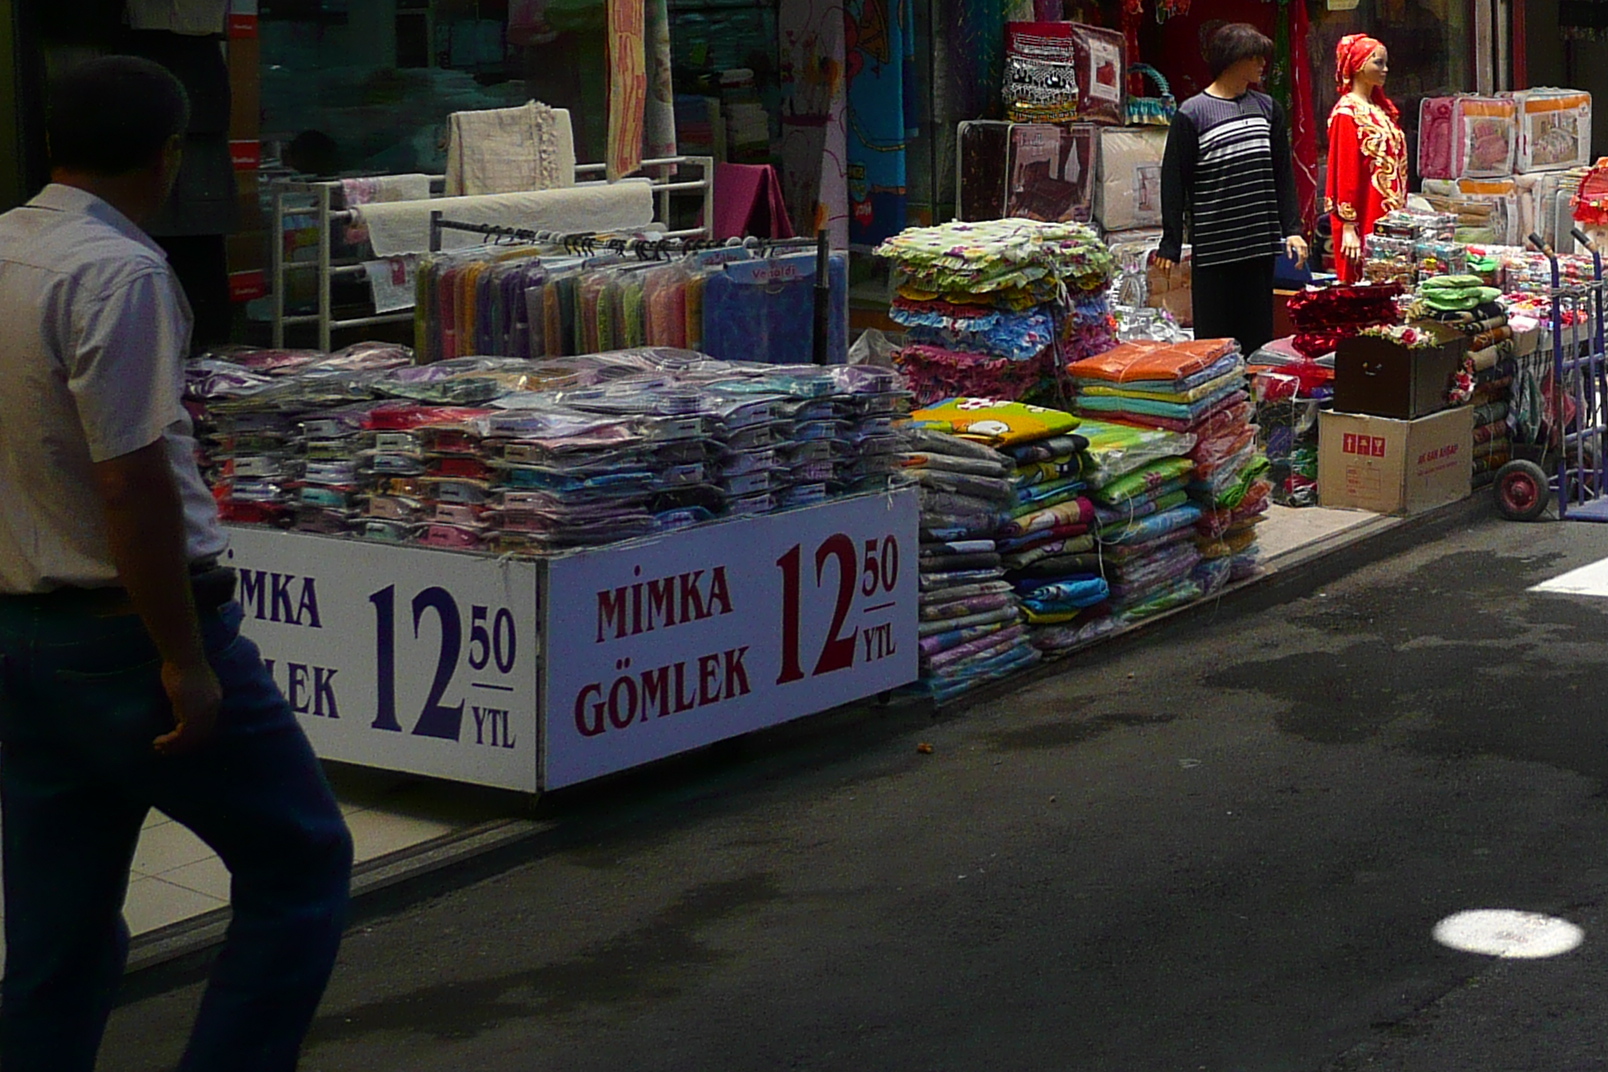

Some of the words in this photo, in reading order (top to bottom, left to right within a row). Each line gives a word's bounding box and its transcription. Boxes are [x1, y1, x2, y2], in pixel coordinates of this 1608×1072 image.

[228, 548, 323, 628] MKA
[595, 564, 734, 644] MİMKA
[775, 532, 859, 686] 12
[862, 534, 899, 598] 50
[368, 583, 466, 743] 12
[468, 604, 517, 674] 50
[863, 622, 897, 663] YTL
[471, 705, 517, 749] YTL
[574, 645, 752, 737] GÖMLEK
